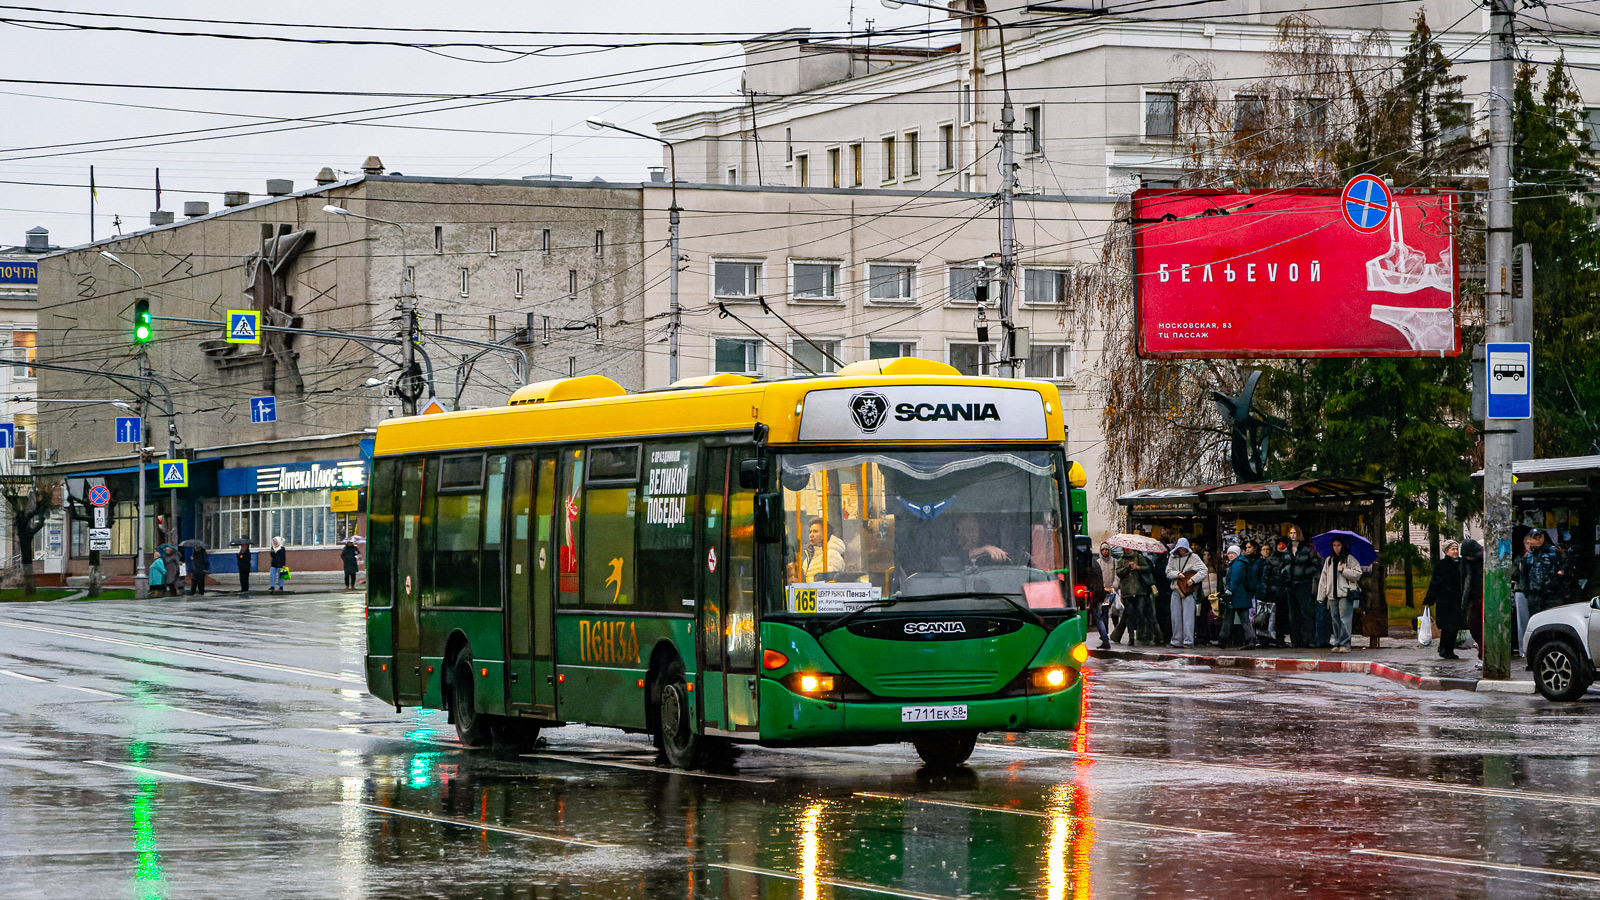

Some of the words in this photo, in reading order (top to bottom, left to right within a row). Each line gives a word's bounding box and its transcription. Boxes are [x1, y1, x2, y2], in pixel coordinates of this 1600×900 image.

[1158, 322, 1219, 330] МОСКОВСКАЯ,
[894, 403, 1001, 422] SCANIA
[648, 464, 689, 495] ВЕЛИКОЙ
[647, 497, 686, 528] ПОБЕДЫ!
[795, 590, 816, 611] 165
[846, 590, 871, 598] Пенза-1
[904, 622, 966, 634] SCANIA
[579, 620, 641, 664] ПЕНЗА
[952, 706, 963, 716] 58
